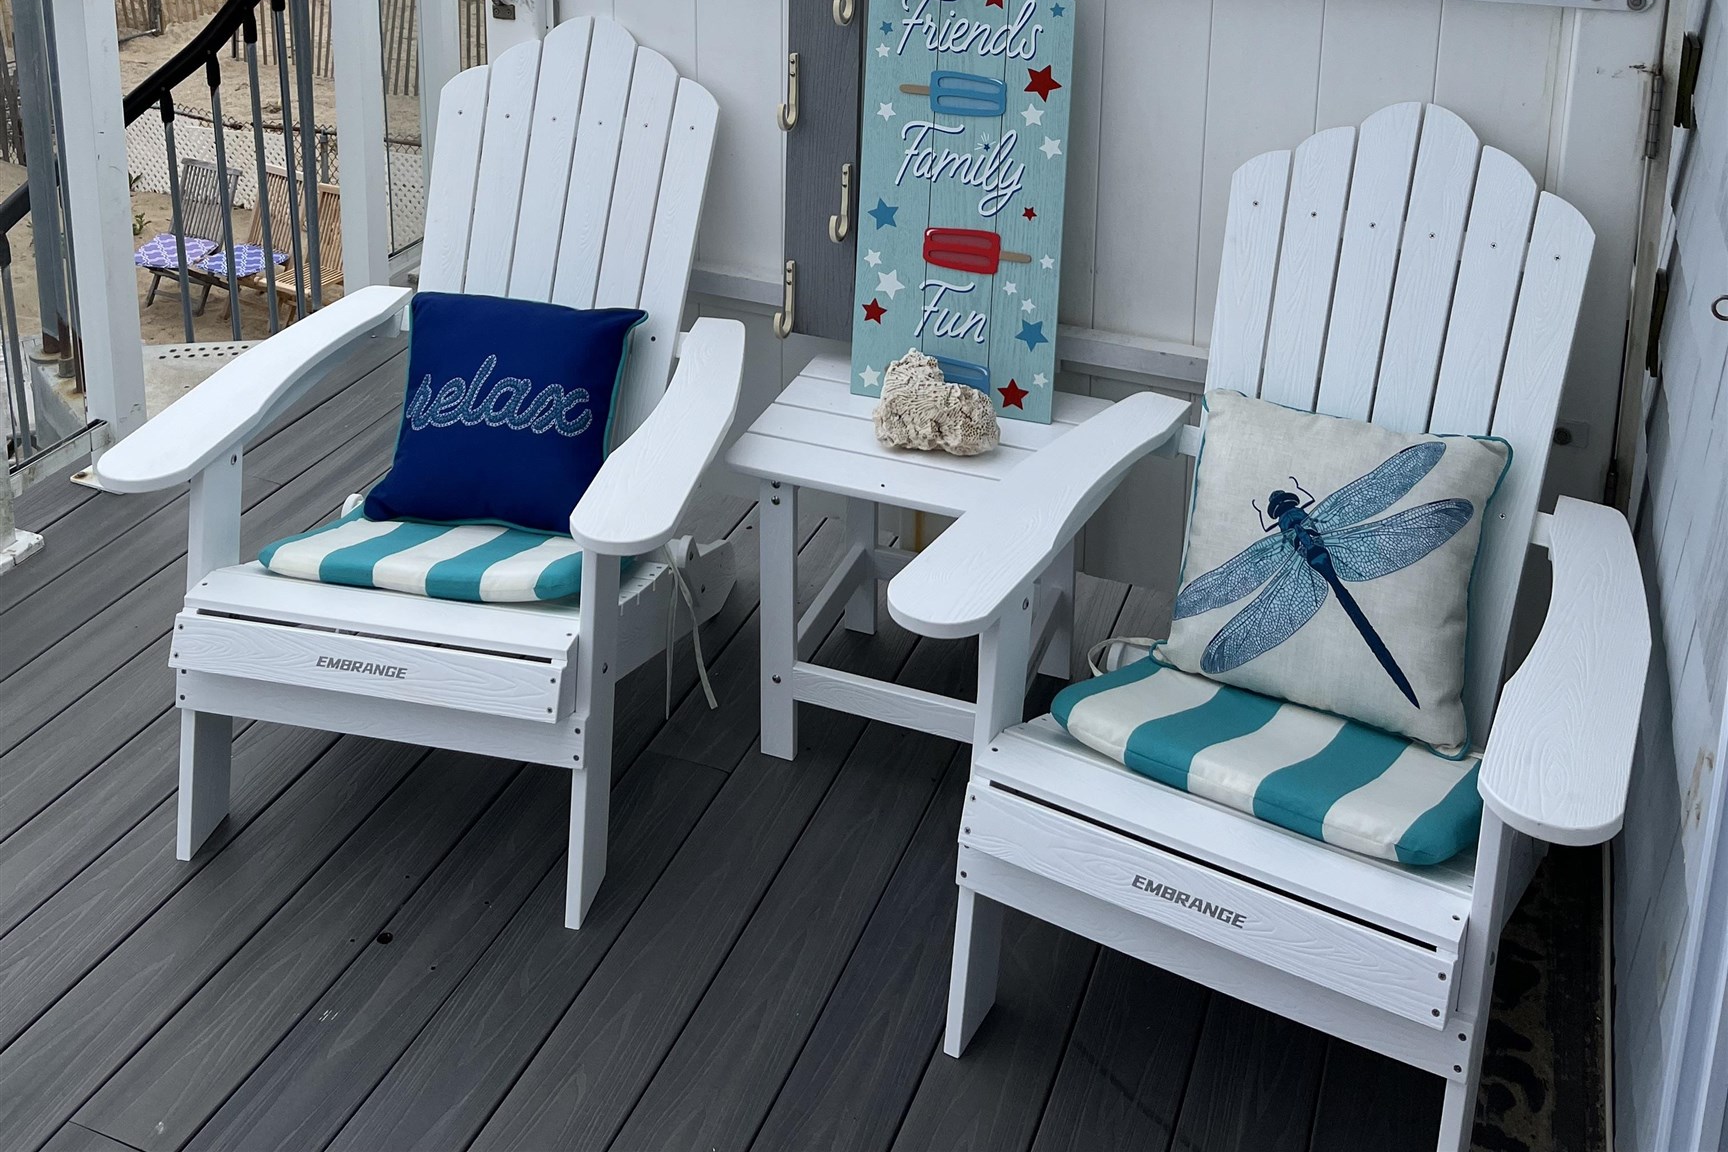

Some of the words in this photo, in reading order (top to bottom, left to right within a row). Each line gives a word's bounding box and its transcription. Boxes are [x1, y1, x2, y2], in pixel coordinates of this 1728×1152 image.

[895, 119, 1027, 218] Family
[913, 278, 989, 344] Fun
[406, 353, 593, 437] relax
[316, 655, 408, 680] EMBRANGE
[1131, 874, 1247, 929] EMBRANGE
